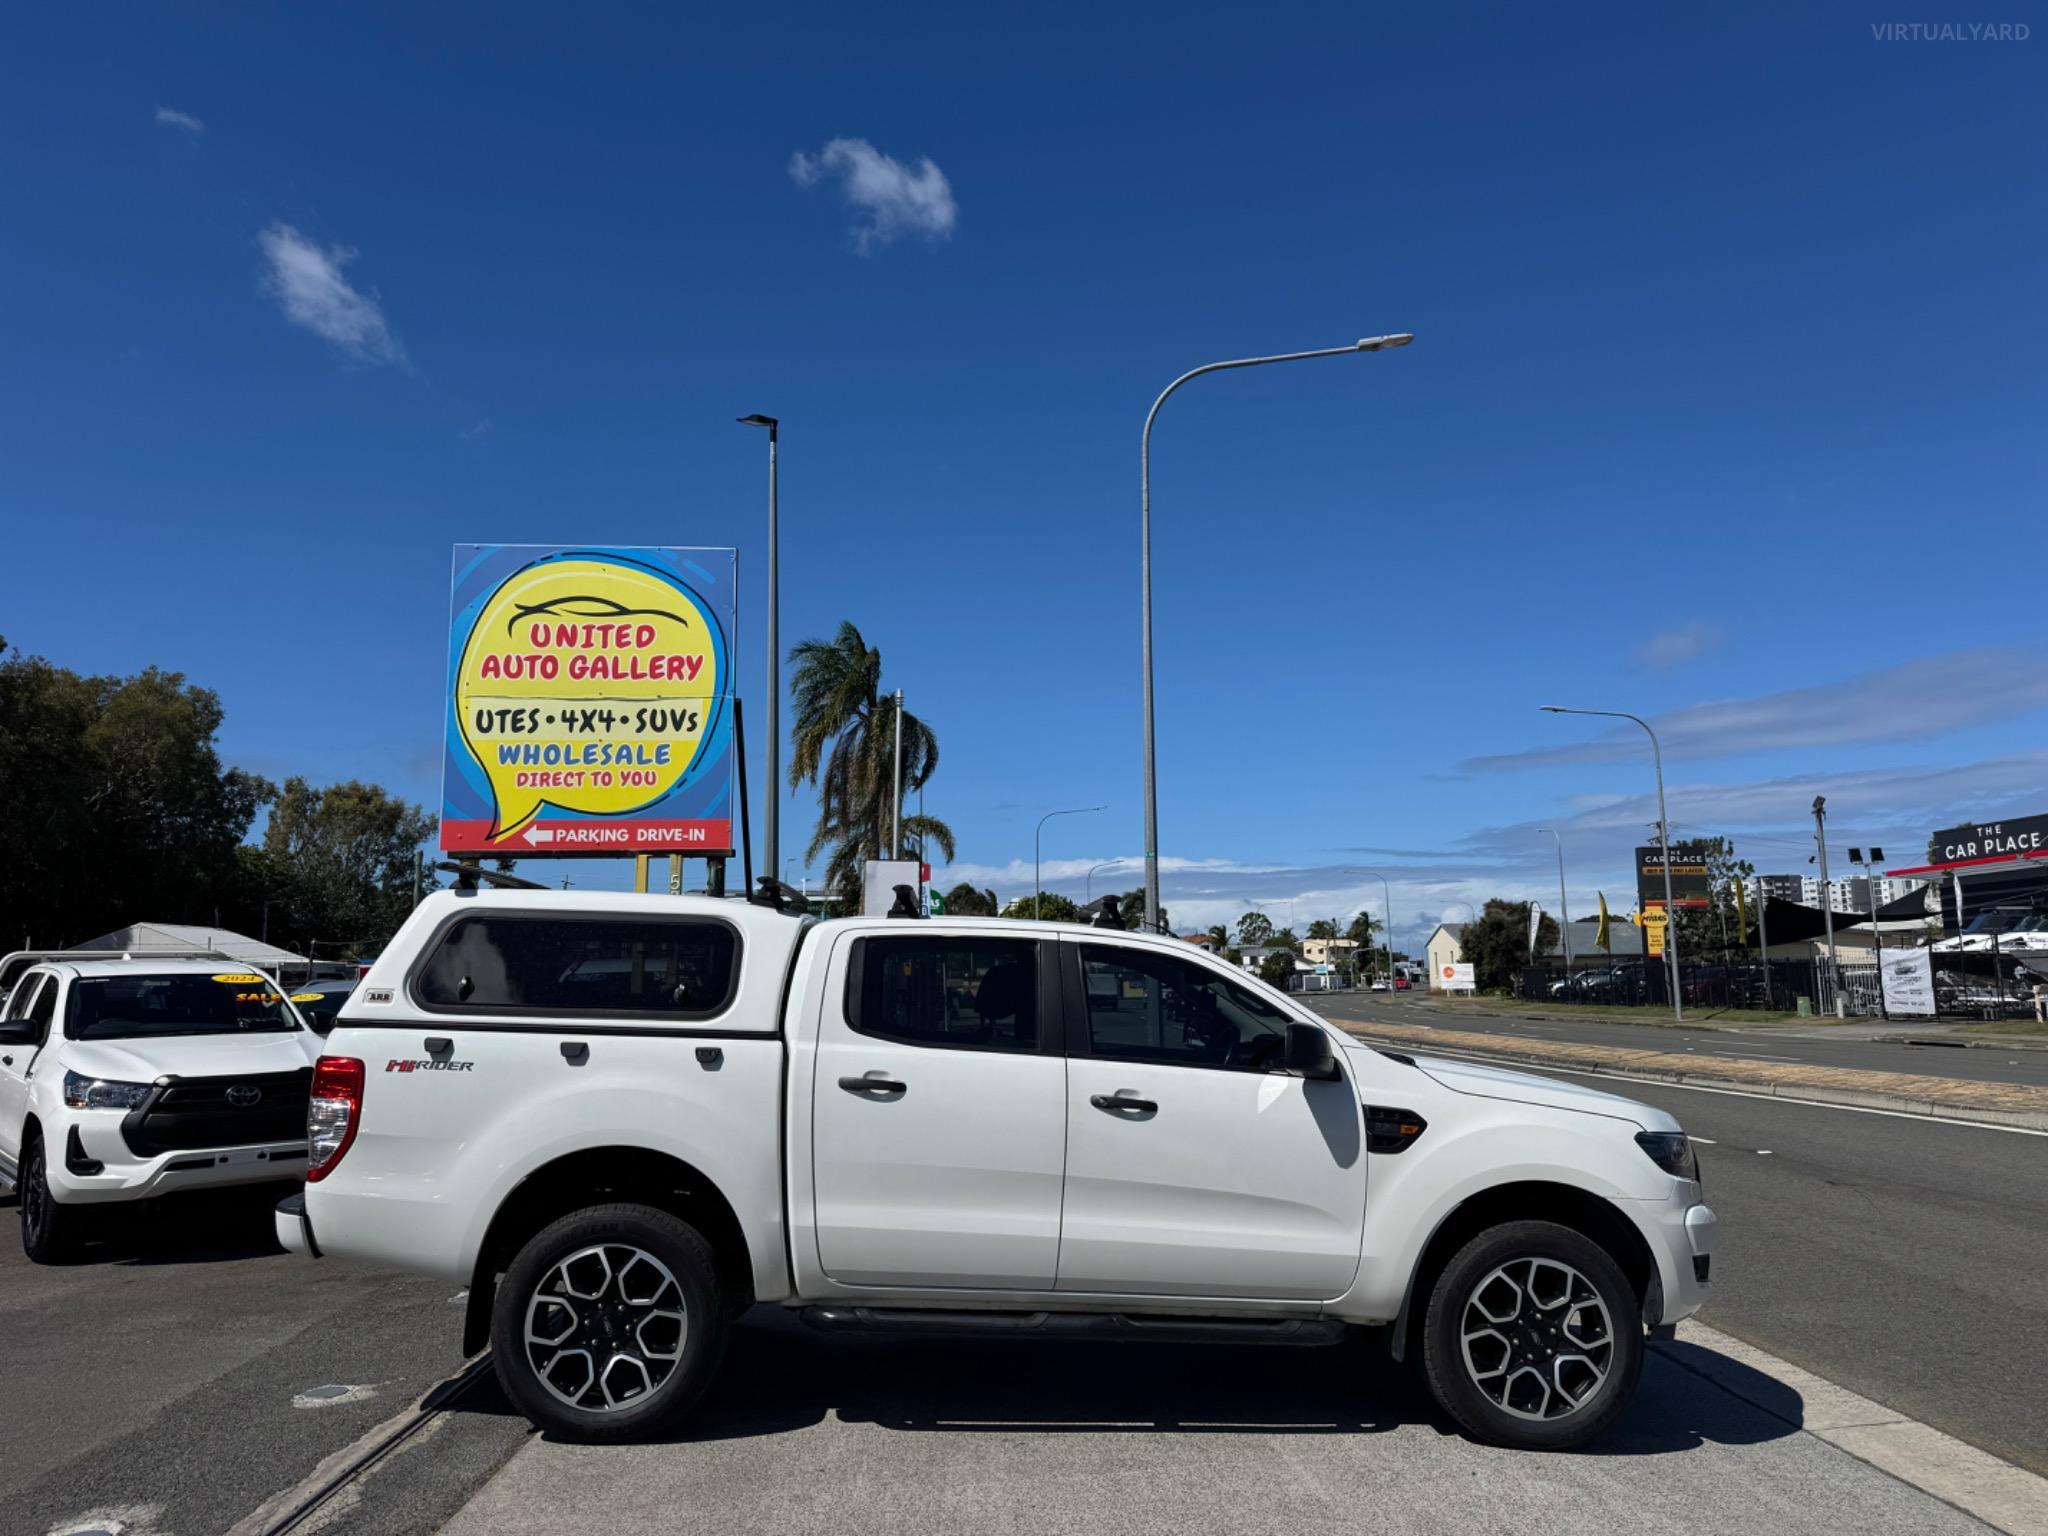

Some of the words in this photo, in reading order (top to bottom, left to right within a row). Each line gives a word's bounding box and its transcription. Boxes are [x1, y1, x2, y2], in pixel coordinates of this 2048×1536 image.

[530, 623, 656, 649] UNITED
[481, 654, 559, 680] AUTO
[569, 654, 704, 681] GALLERY
[475, 708, 539, 734] UTES
[561, 708, 615, 733] 4X4
[635, 708, 698, 733] SUVs
[498, 743, 671, 766] WHOLESALE
[516, 771, 584, 787] DIRECT
[590, 771, 611, 787] TO
[620, 771, 657, 786] YOU
[556, 829, 628, 843] PARKING
[637, 829, 705, 842] DRIVE-IN
[1976, 824, 2001, 837] THE
[1945, 842, 1977, 860] CAR
[1984, 832, 2040, 854] PLACE
[236, 993, 281, 1003] SALE
